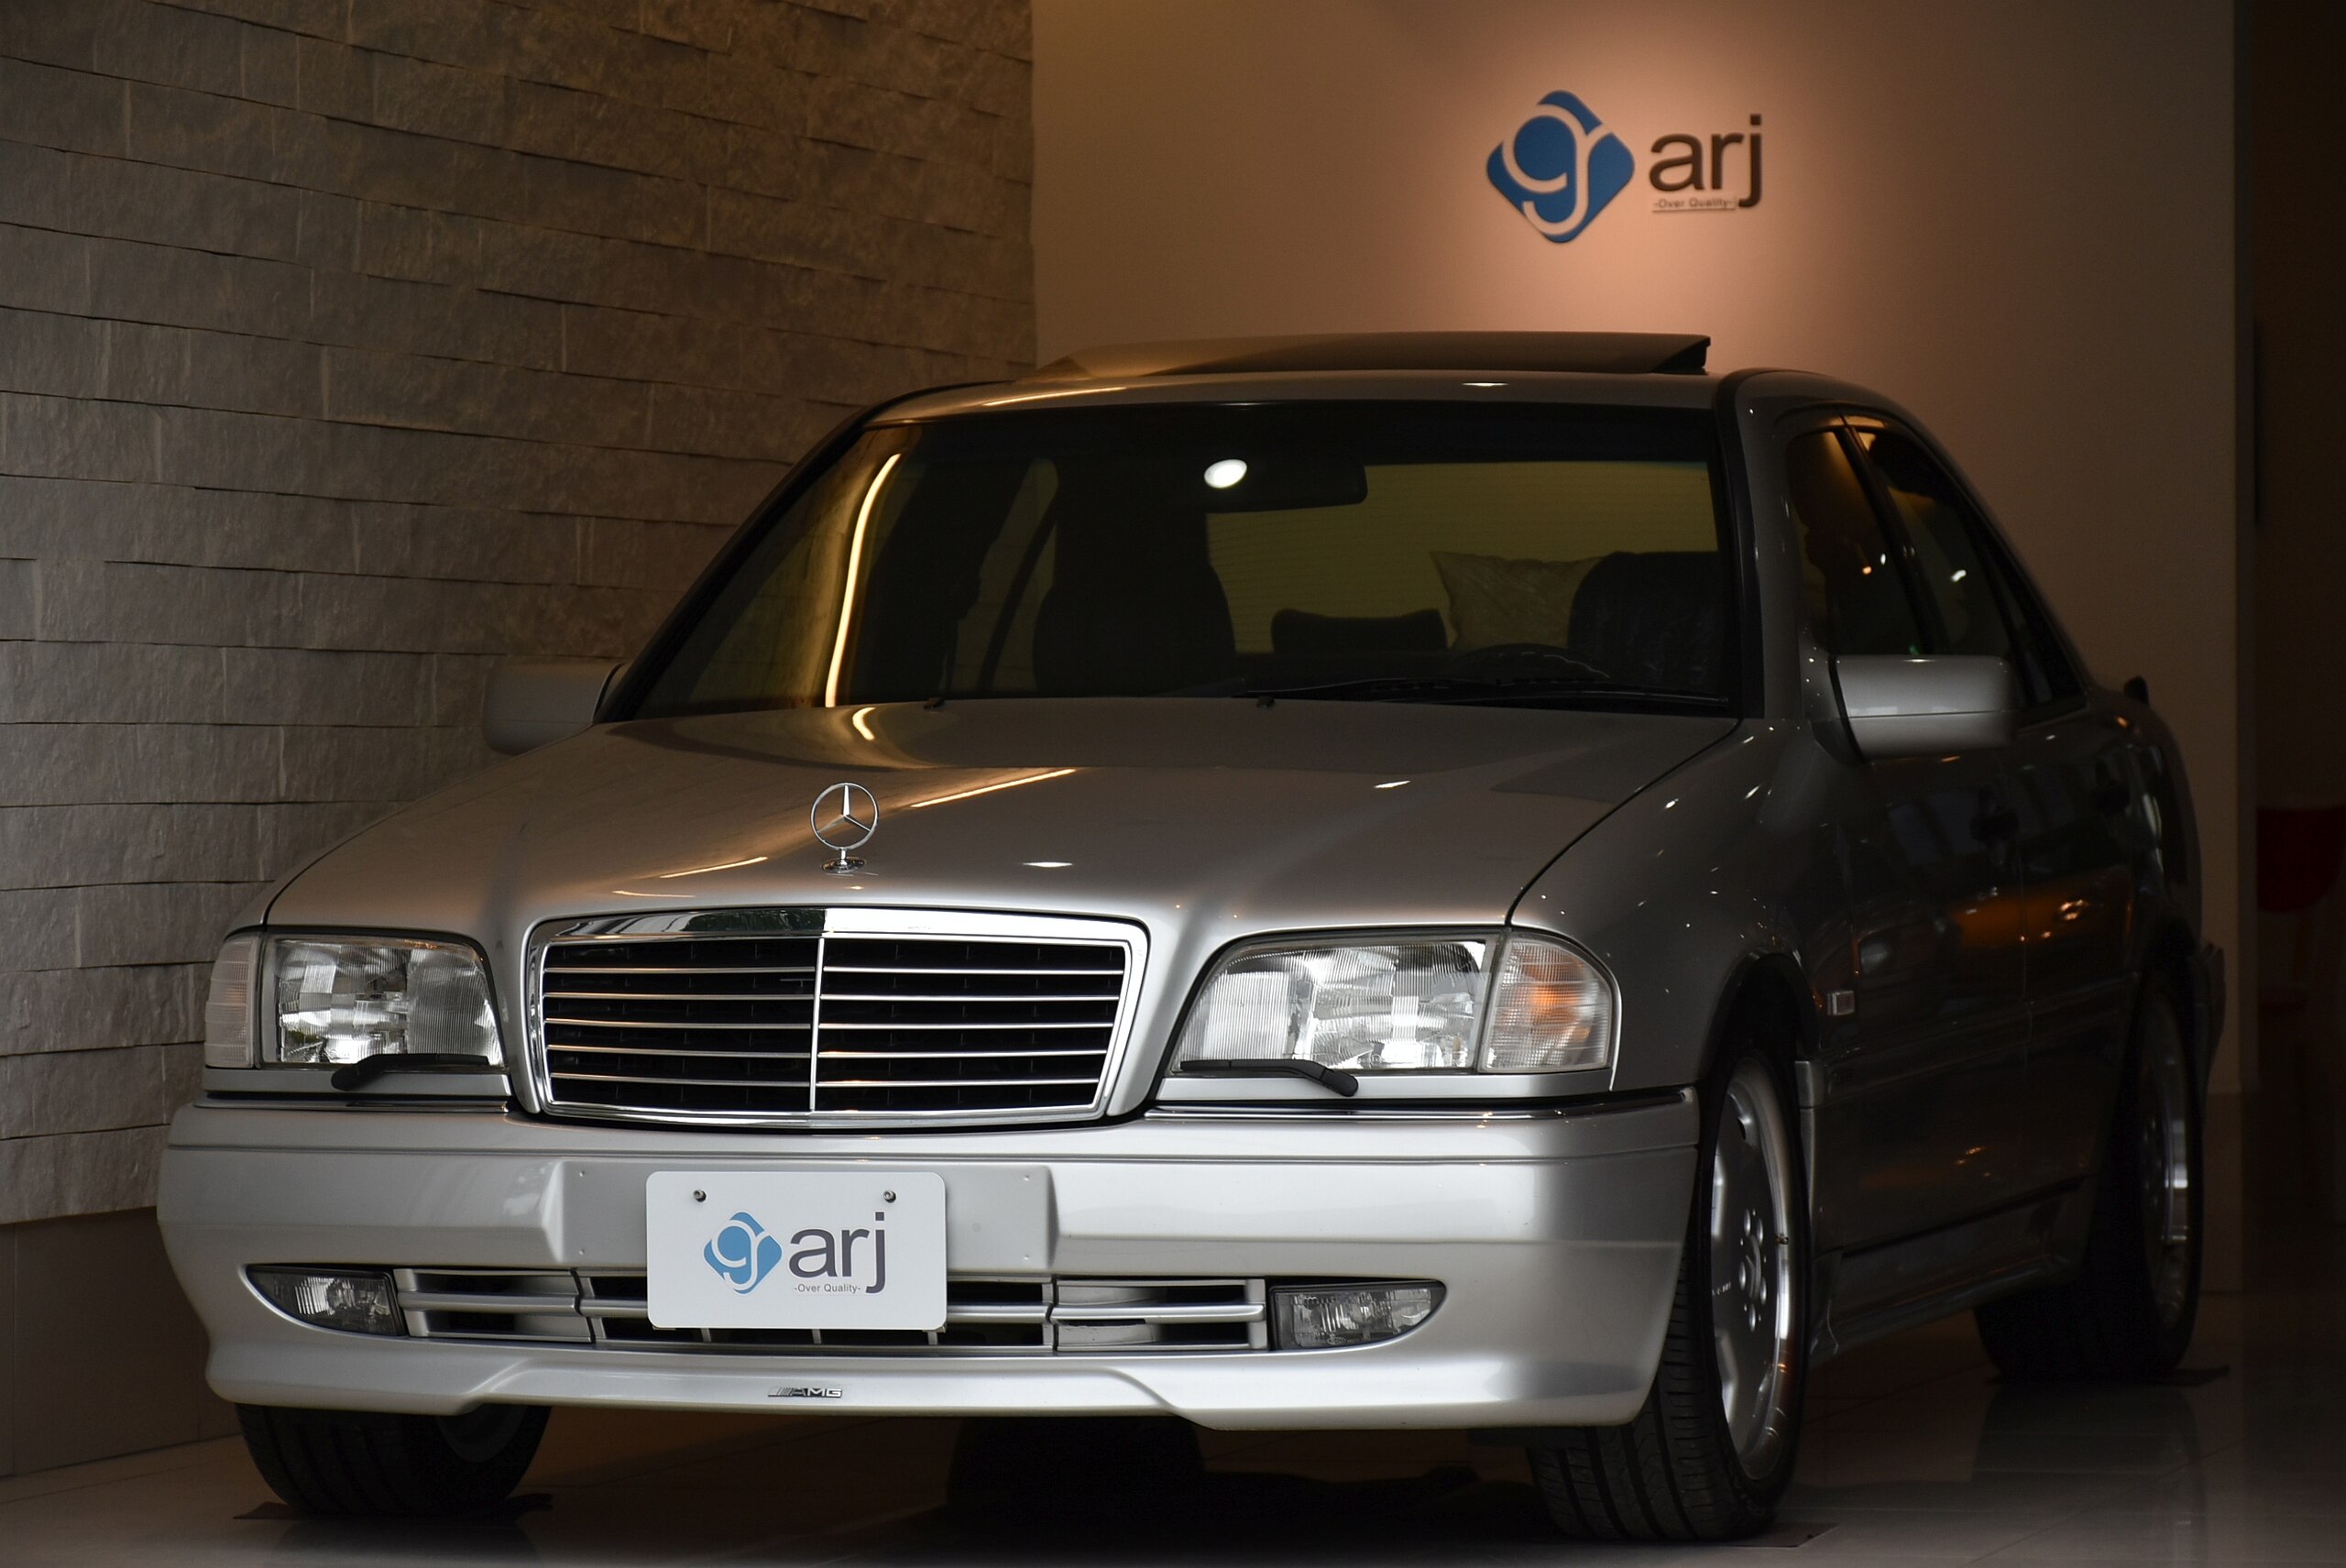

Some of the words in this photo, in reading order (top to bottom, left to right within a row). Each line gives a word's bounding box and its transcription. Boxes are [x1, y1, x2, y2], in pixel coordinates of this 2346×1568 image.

[1649, 113, 1762, 209] arj
[788, 1211, 887, 1294] arj
[789, 1387, 843, 1398] AMG
